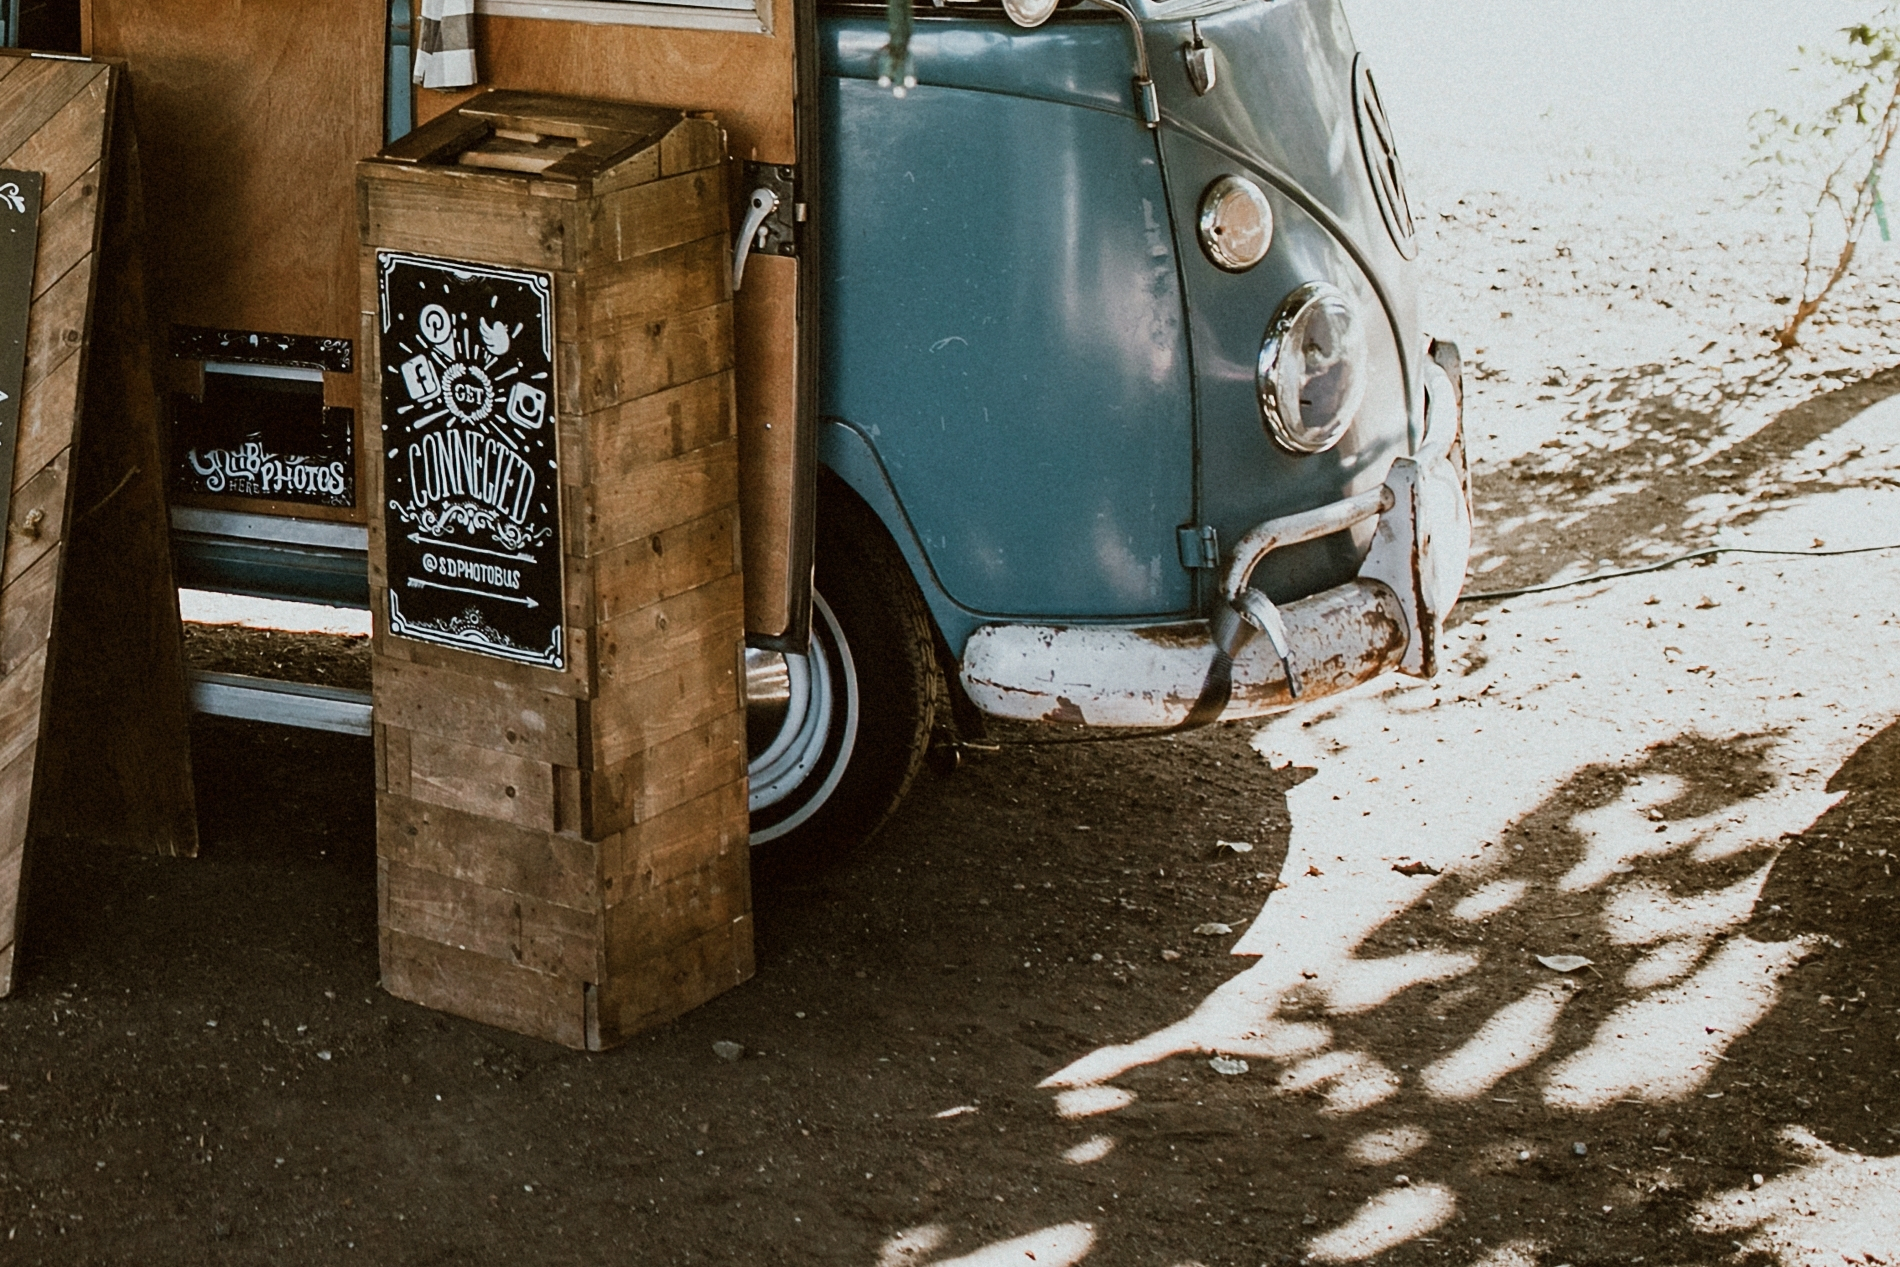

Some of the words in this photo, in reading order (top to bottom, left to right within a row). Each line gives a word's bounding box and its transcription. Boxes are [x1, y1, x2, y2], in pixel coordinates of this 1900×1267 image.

[454, 383, 484, 405] GET
[228, 478, 260, 495] HERE
[260, 461, 344, 495] PHOTOS
[408, 429, 536, 525] CONNECTED
[422, 552, 521, 589] @SDPHOTOBUS
